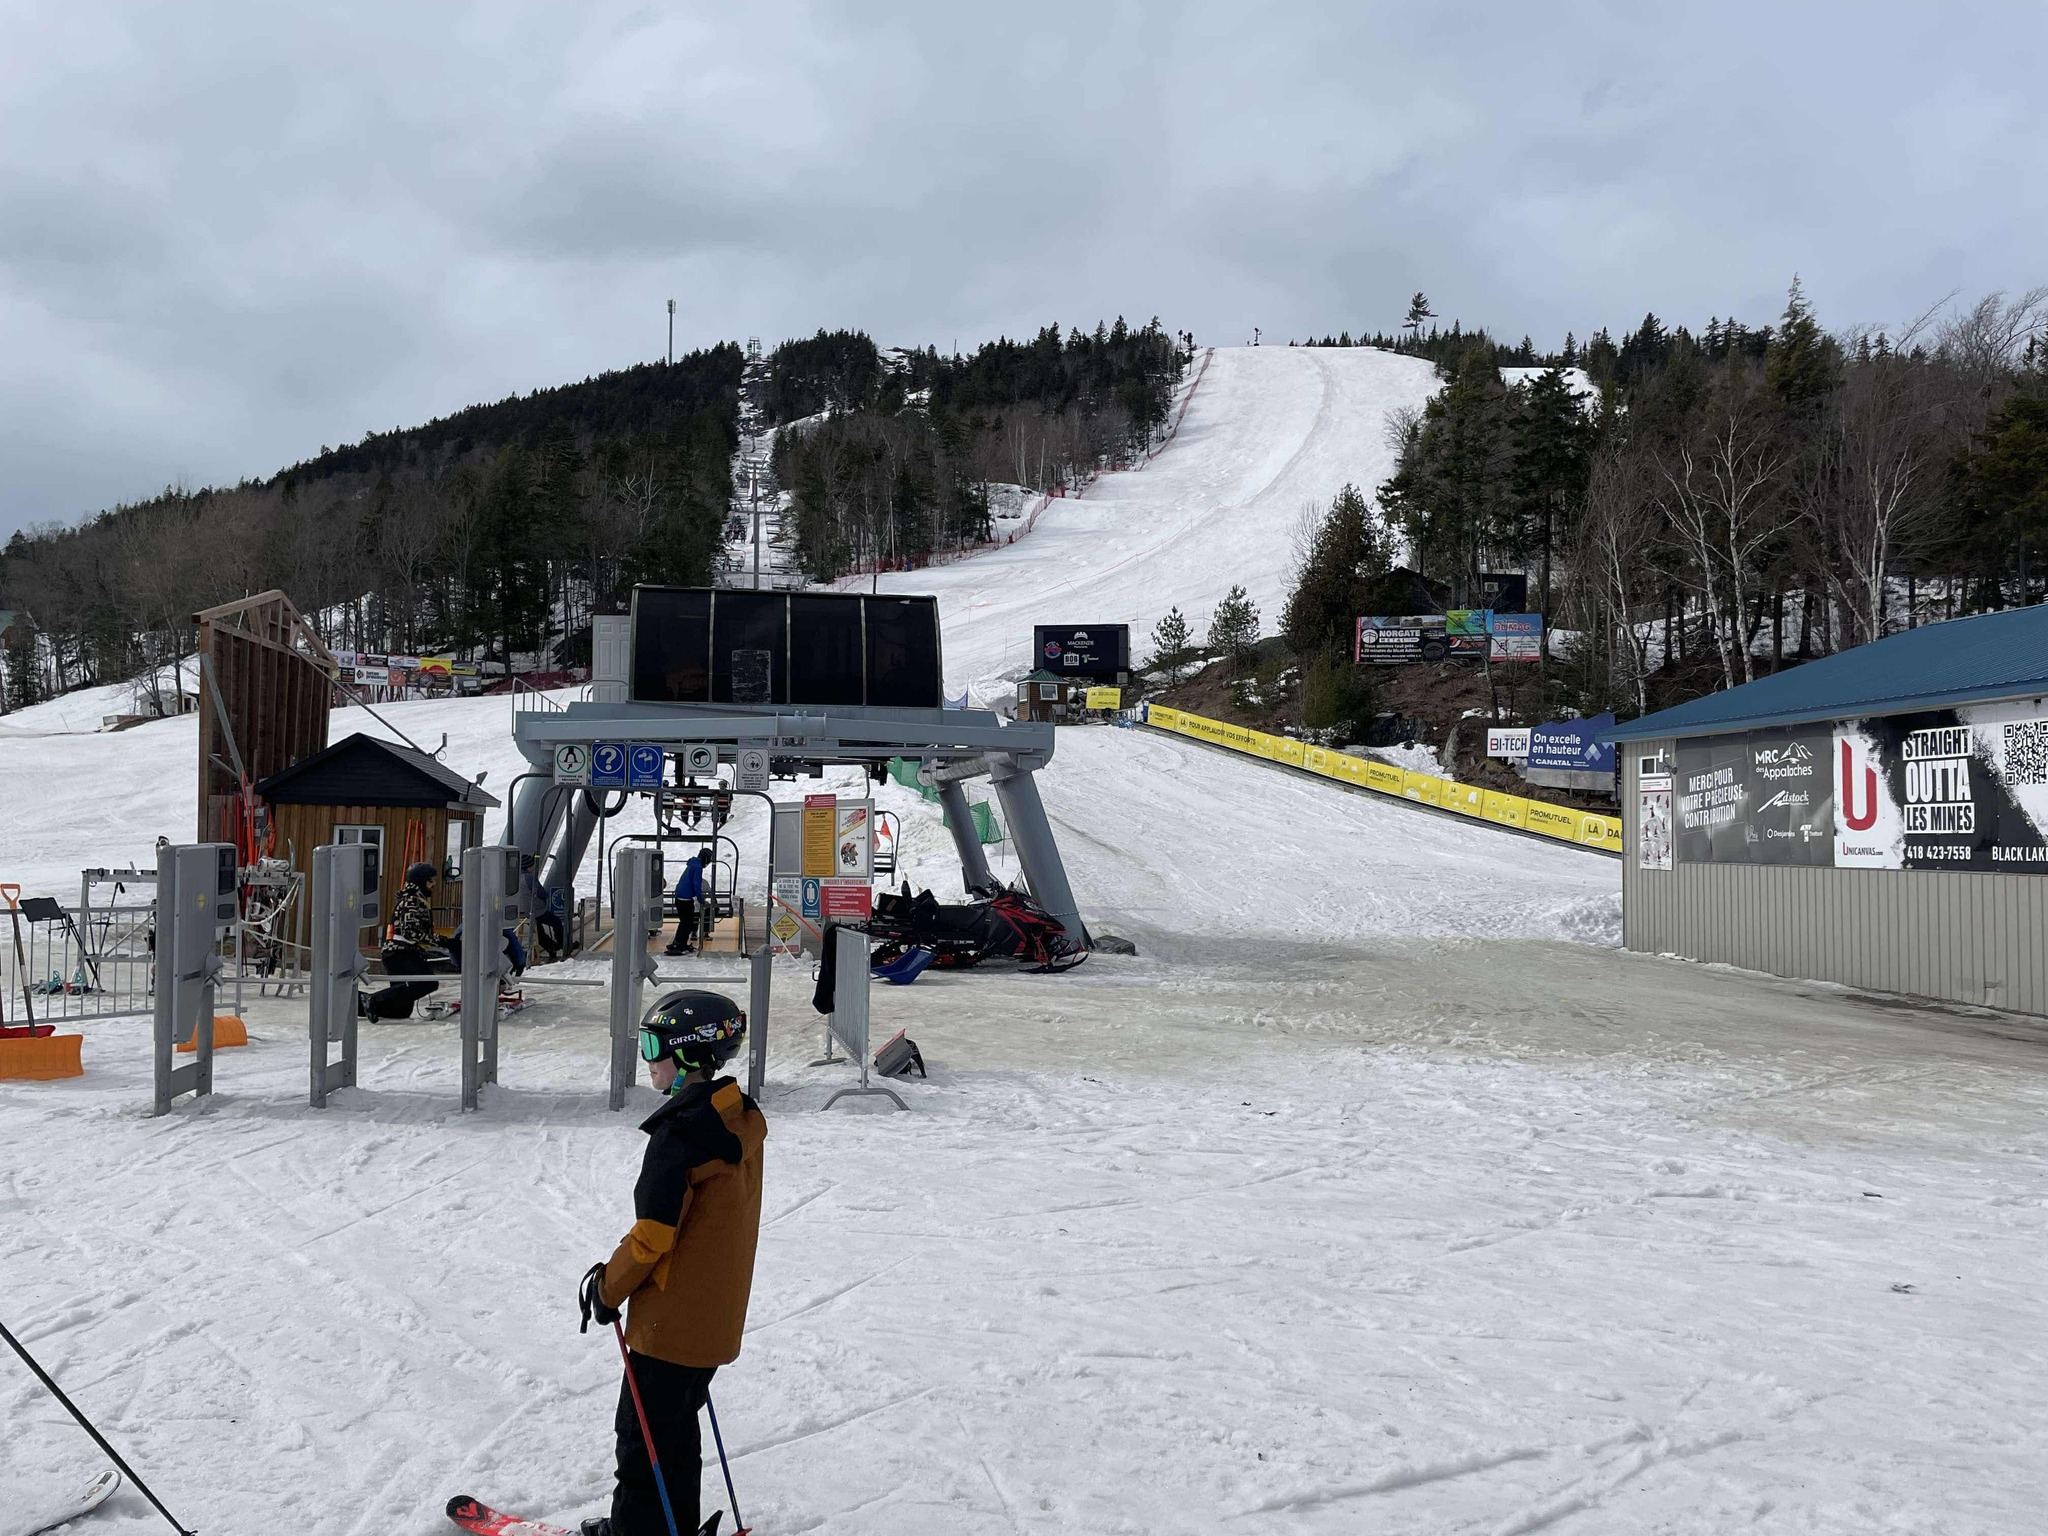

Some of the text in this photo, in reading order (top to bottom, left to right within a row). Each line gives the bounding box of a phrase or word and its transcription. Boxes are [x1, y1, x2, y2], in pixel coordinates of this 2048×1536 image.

[1379, 629, 1421, 637] NORGATE
[1065, 655, 1078, 663] BOB
[1189, 721, 1201, 730] POUR
[1200, 725, 1226, 737] APPLAUDIR
[1226, 731, 1236, 739] VOS
[1235, 733, 1256, 746] EFFORTS
[1534, 733, 1581, 745] On excelle
[1532, 744, 1581, 755] en hauteur
[1905, 728, 1970, 758] STRAIGHT
[1536, 758, 1571, 766] CANATAL
[1755, 749, 1779, 764] MRC
[1369, 768, 1400, 782] PROMUTUEL
[1689, 774, 1713, 792] MERCI
[1714, 767, 1734, 788] POUR
[1763, 765, 1813, 780] Appalaches
[1905, 759, 1971, 803] OUTTA
[1681, 795, 1703, 812] VOTRE
[1530, 808, 1572, 825] PROMUTUEL
[1684, 803, 1736, 828] CONTRIBUTION
[1906, 805, 1972, 831] LES MINES
[1588, 822, 1622, 840] LÀ DA
[1773, 829, 1796, 838] Desjardins
[1907, 846, 1972, 861] 418 423-7558
[1992, 846, 2024, 861] BLACK
[669, 1033, 696, 1046] GIRO
